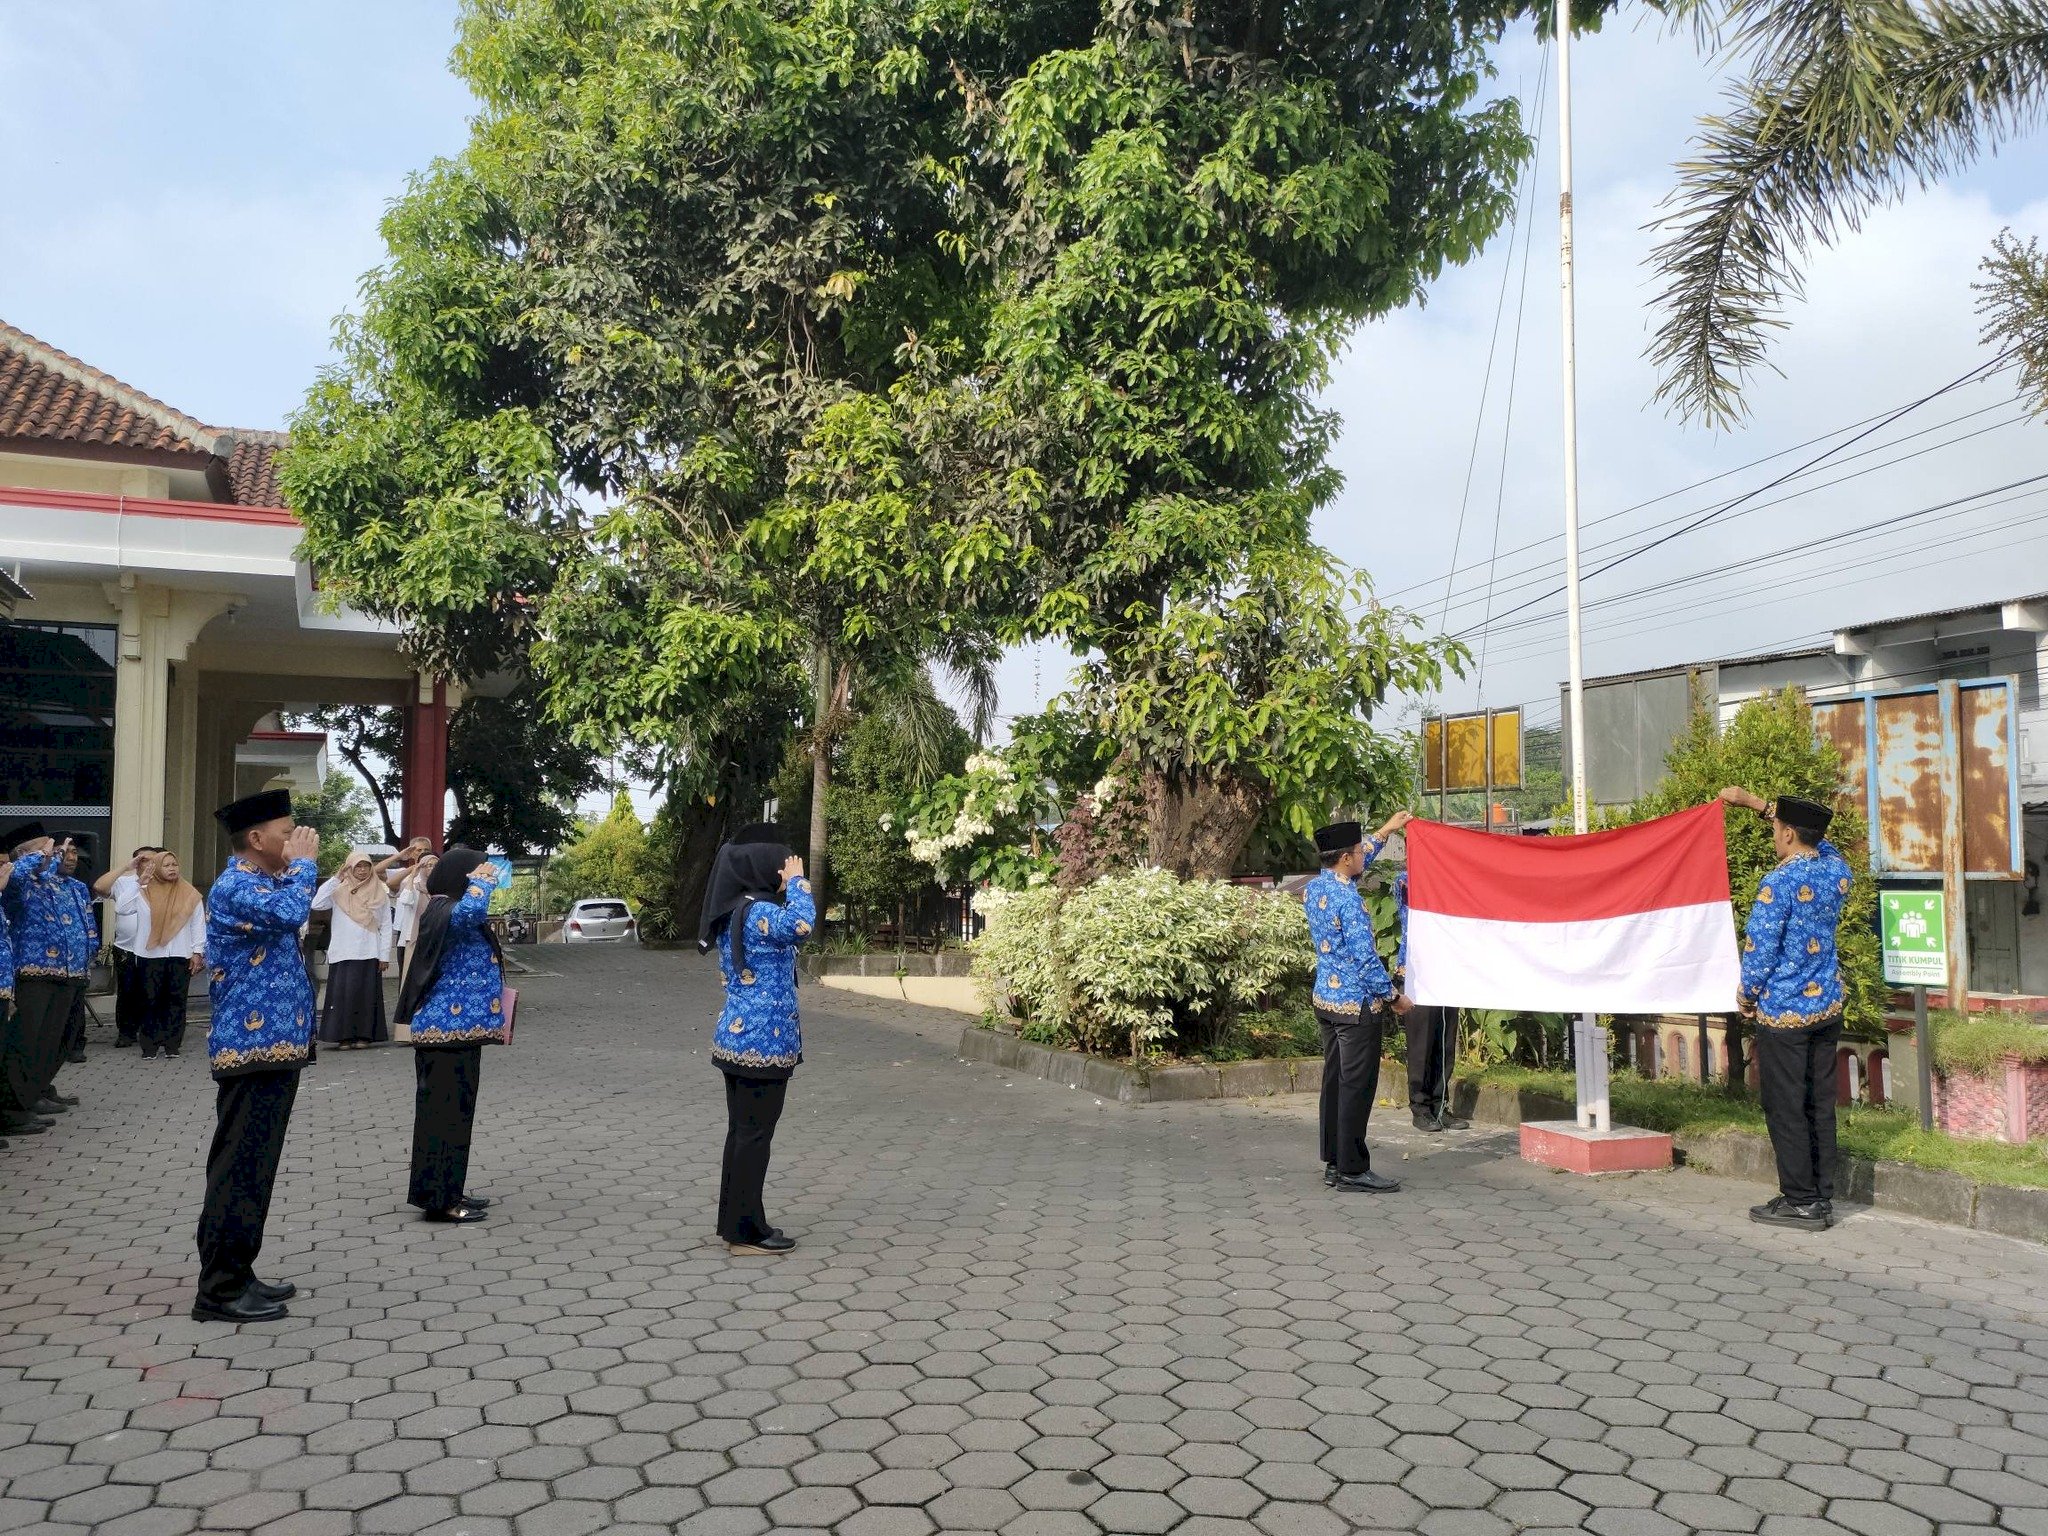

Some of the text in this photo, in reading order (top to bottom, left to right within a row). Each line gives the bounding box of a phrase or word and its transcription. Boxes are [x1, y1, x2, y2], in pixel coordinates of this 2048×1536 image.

[1888, 955, 1943, 965] TITIK KUMPUL
[1891, 969, 1921, 978] Assembly
